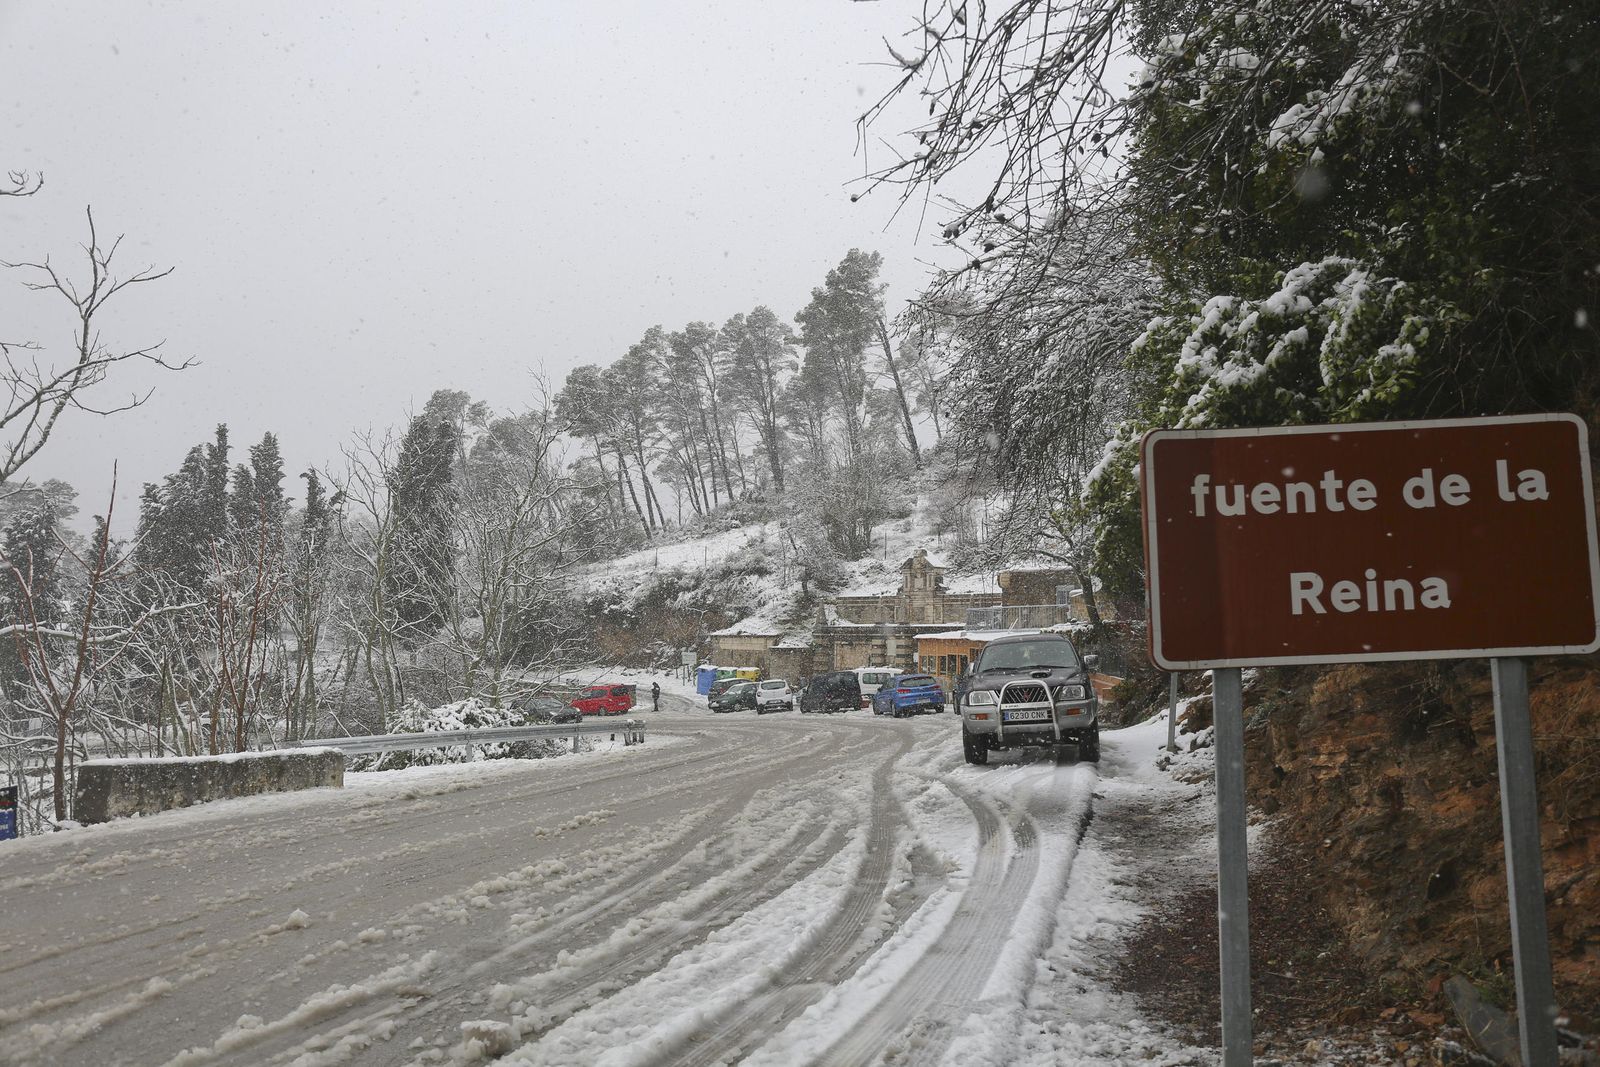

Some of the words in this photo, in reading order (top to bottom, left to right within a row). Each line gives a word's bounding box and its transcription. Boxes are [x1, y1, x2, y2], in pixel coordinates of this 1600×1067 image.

[1190, 469, 1378, 517] fuente
[1402, 467, 1471, 509] de
[1495, 459, 1550, 502] la
[1290, 568, 1452, 615] Reina
[1010, 711, 1029, 720] 6230
[1031, 711, 1046, 719] CNK
